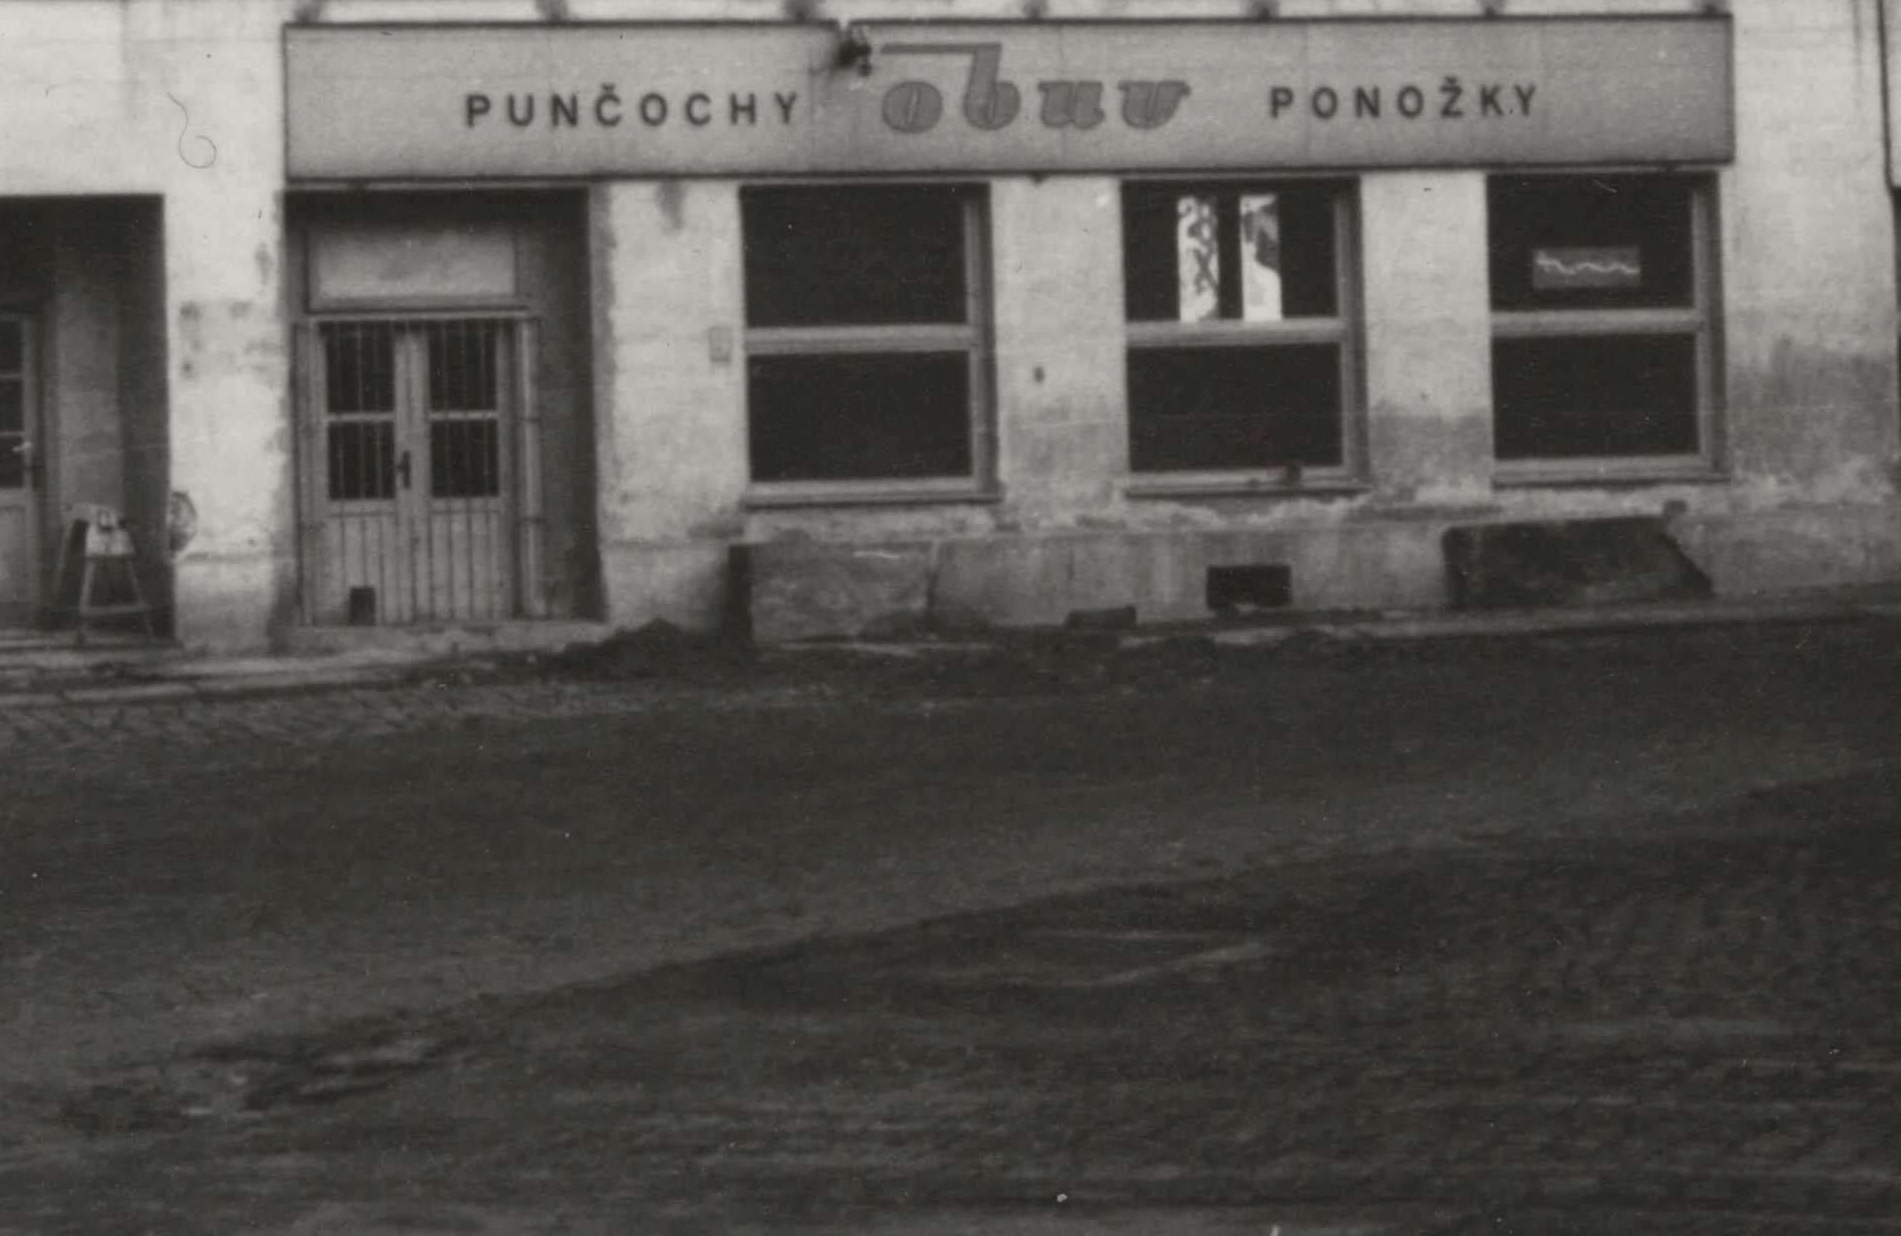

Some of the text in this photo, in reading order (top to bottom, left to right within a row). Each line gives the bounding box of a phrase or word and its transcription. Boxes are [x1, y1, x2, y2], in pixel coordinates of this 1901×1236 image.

[465, 83, 798, 127] PUNČOCHY
[881, 43, 1191, 134] obuv
[1271, 77, 1538, 118] PONOŽKY
